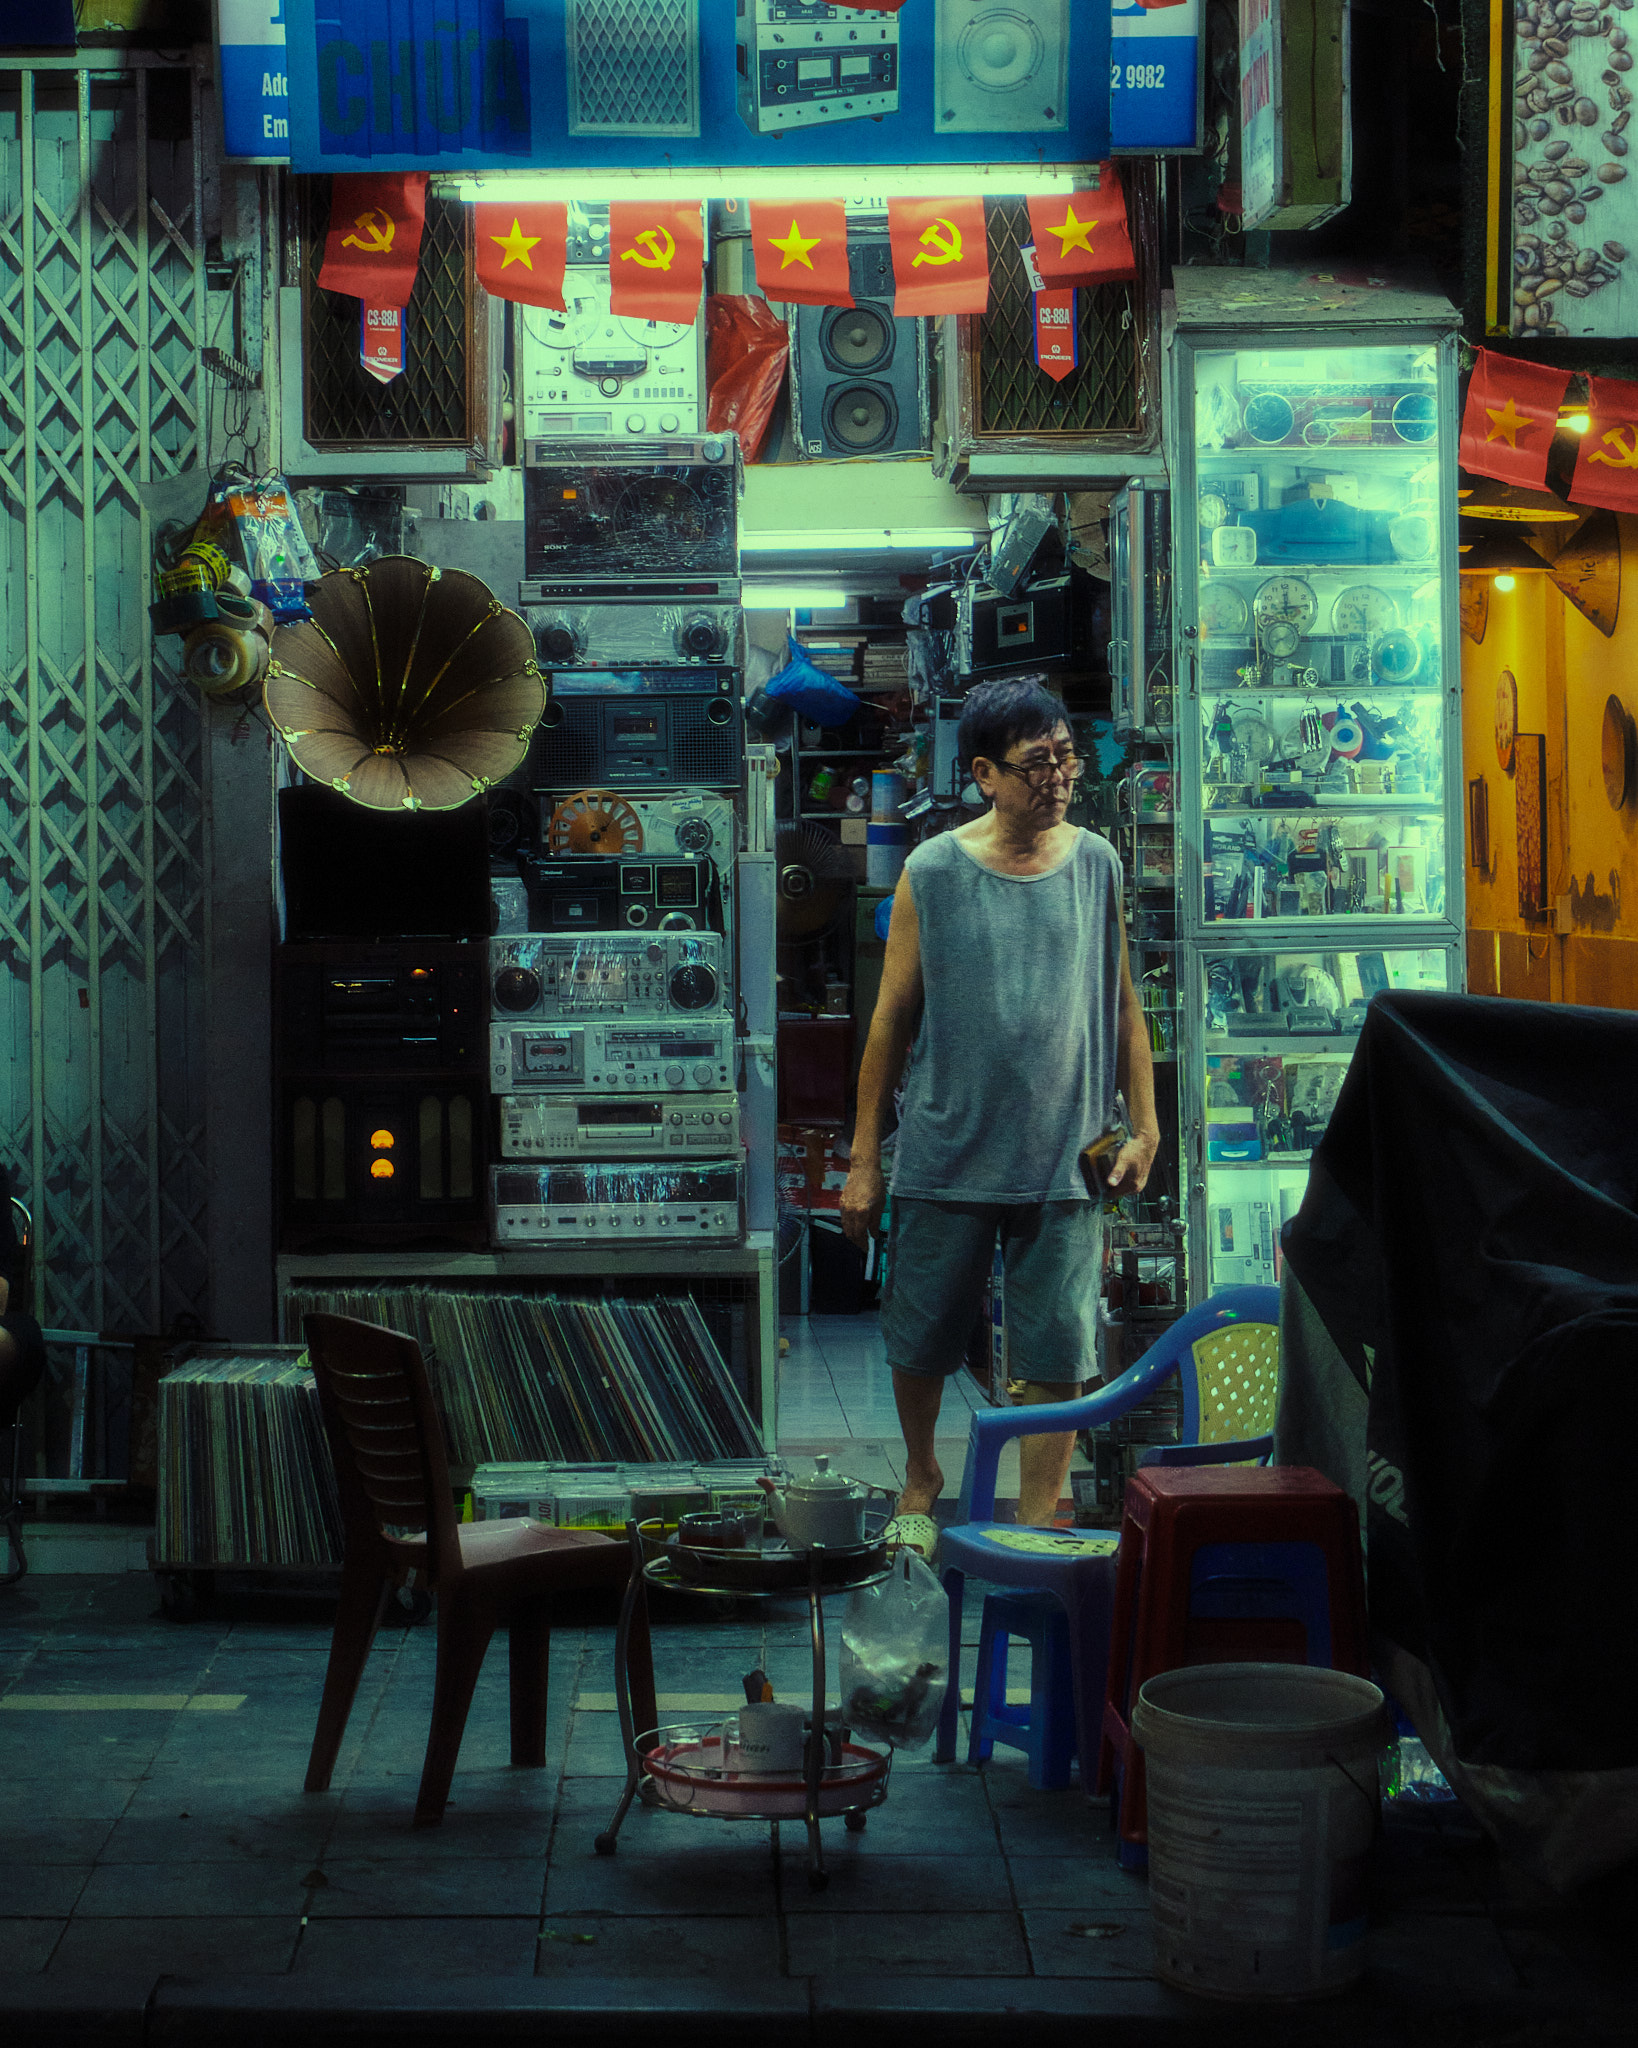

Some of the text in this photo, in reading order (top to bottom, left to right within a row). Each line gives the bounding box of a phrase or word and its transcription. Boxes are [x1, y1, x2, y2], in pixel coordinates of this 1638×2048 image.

[1126, 65, 1165, 88] 9982
[263, 114, 288, 138] Em
[367, 309, 398, 326] CS-88A
[1040, 308, 1070, 324] CS-88A
